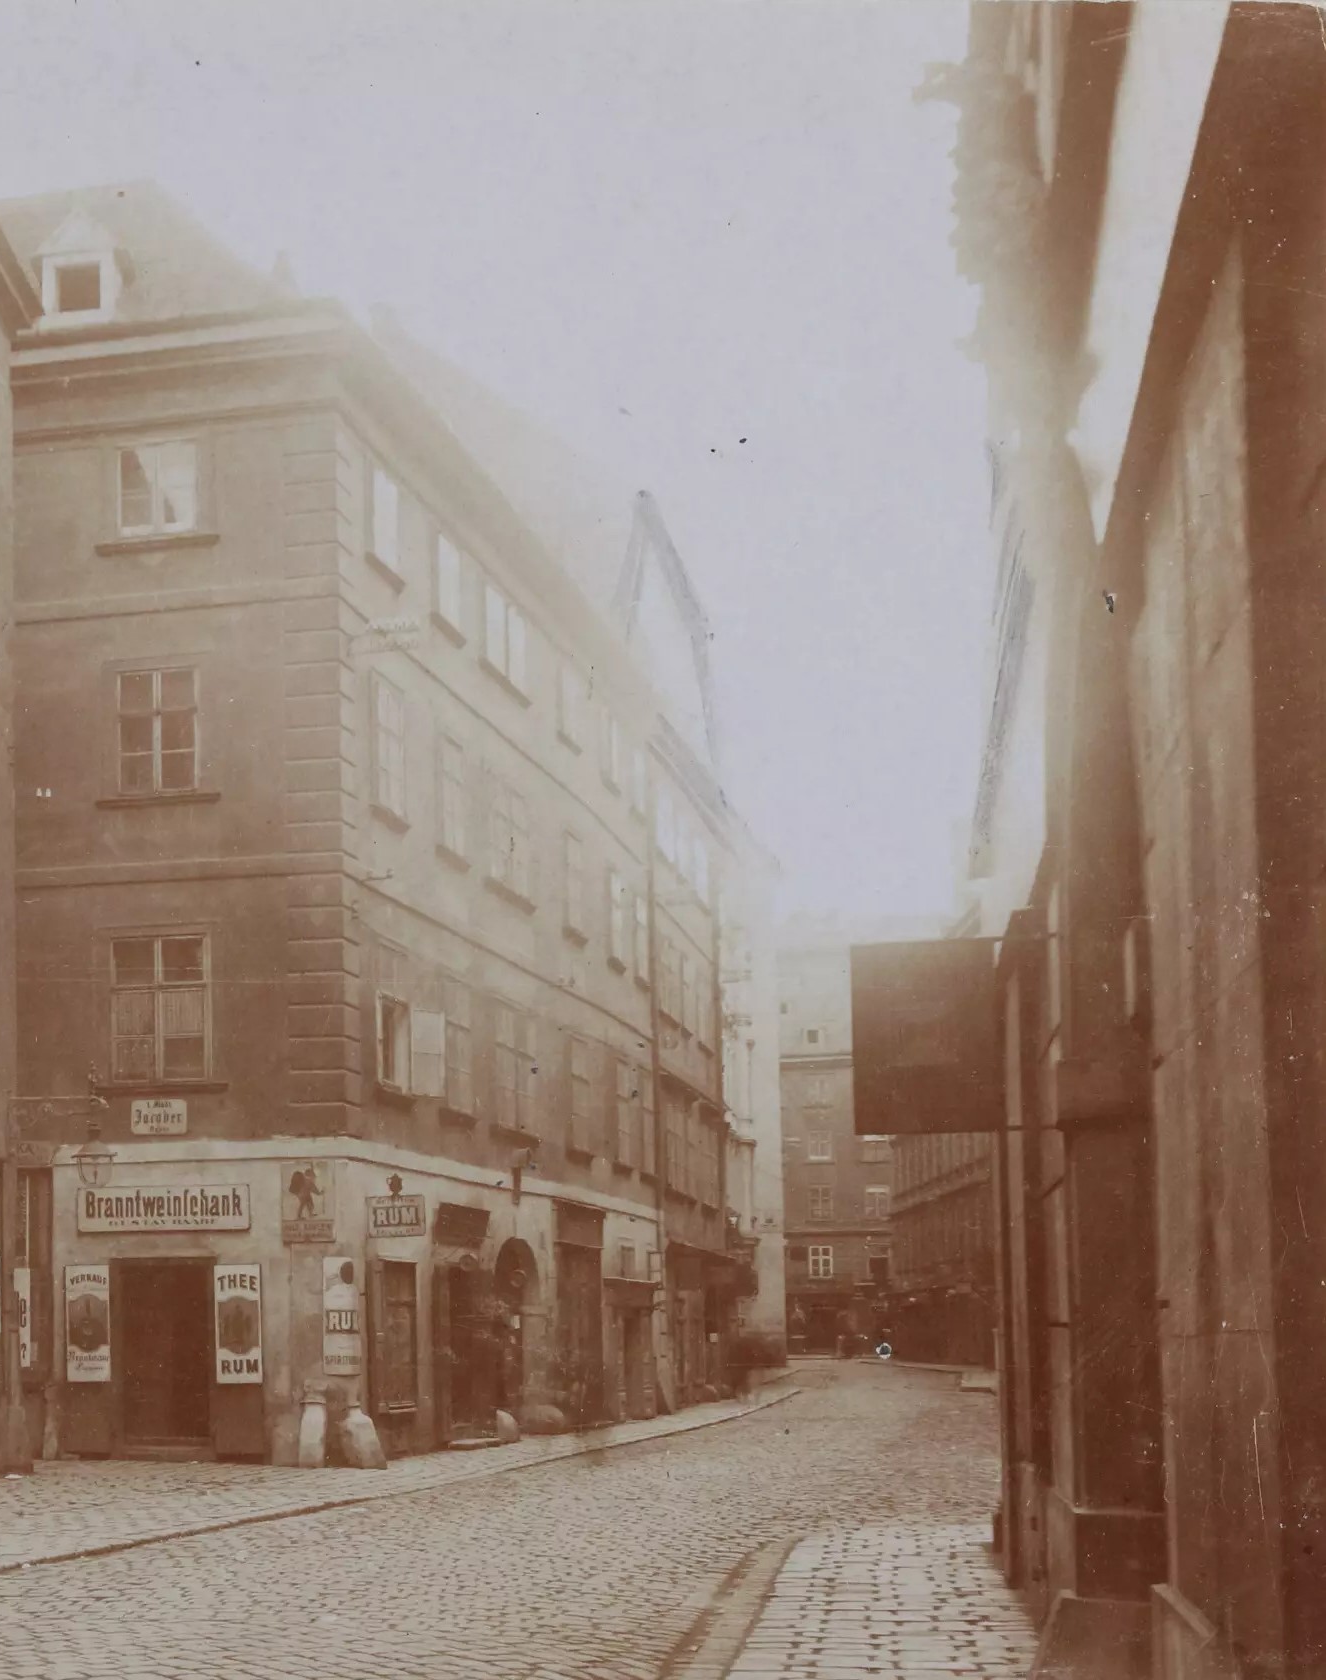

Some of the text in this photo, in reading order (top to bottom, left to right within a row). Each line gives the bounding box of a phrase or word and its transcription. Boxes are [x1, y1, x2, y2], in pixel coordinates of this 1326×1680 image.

[376, 1207, 418, 1226] RUM
[217, 1274, 258, 1292] THEE
[221, 1359, 259, 1376] RUM
